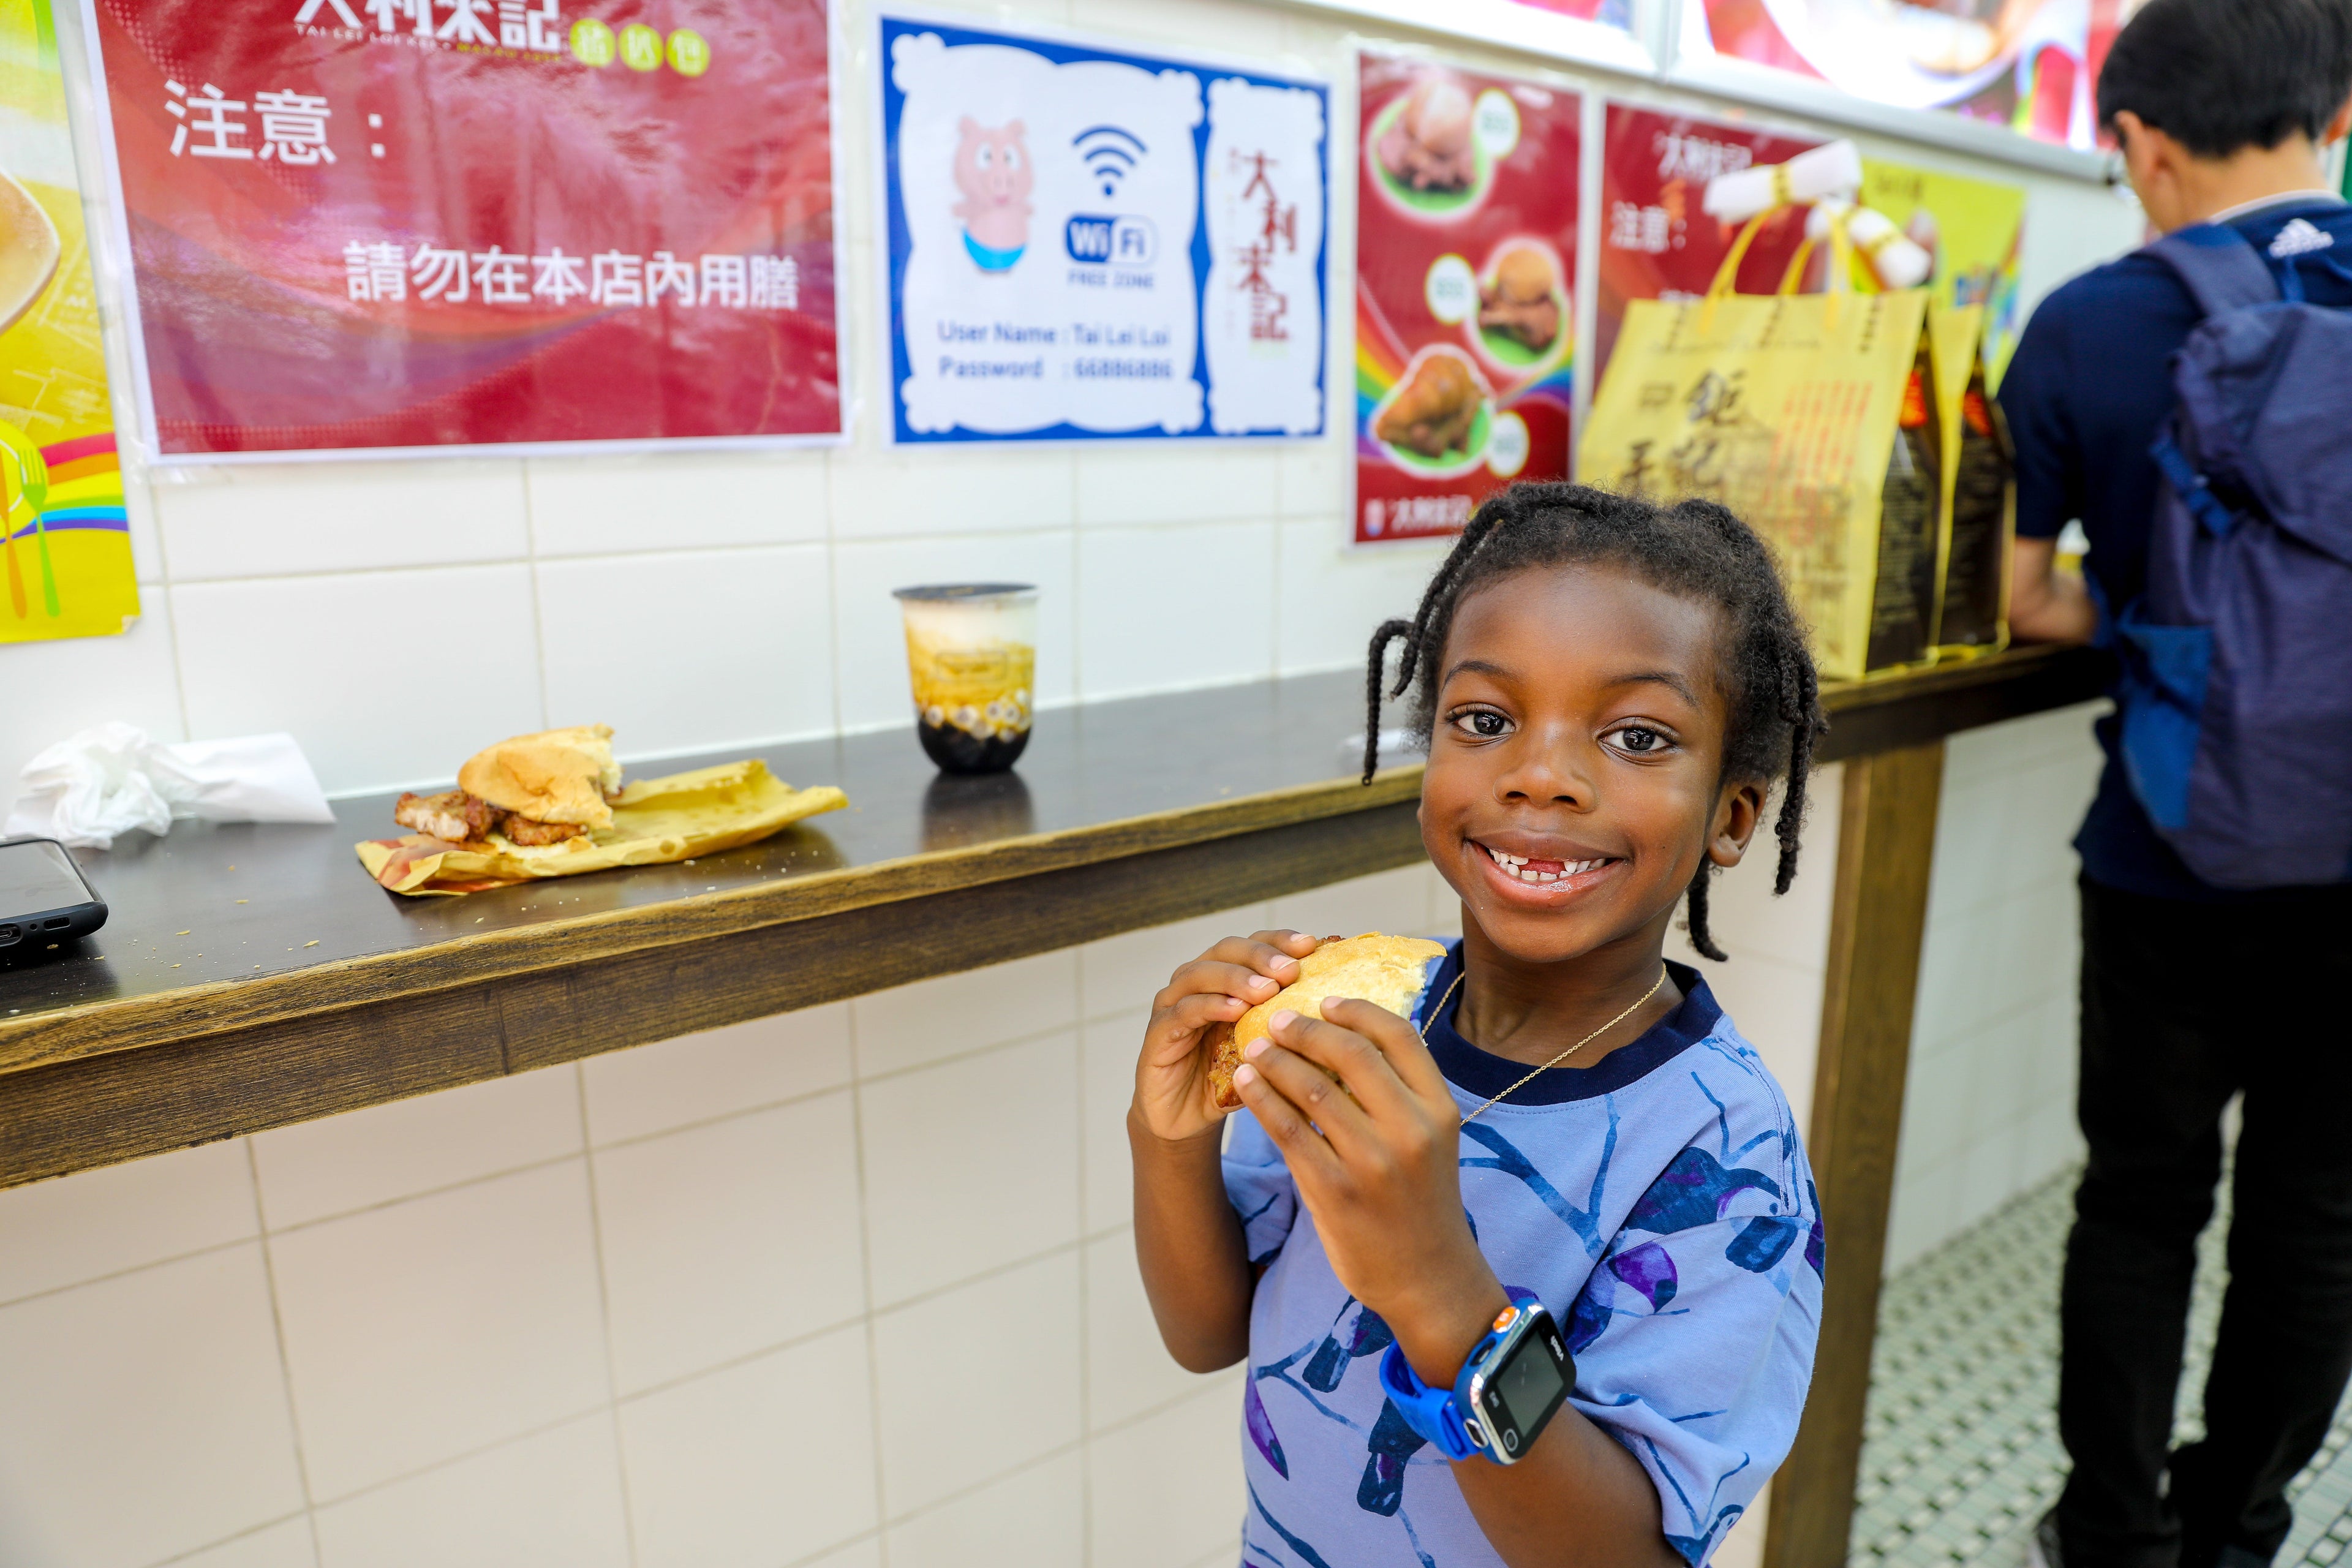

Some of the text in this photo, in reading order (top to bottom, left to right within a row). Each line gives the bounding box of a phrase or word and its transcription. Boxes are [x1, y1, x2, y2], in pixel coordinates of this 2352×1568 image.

[938, 320, 987, 342] User
[993, 322, 1057, 344] Name
[938, 355, 1044, 379] Password
